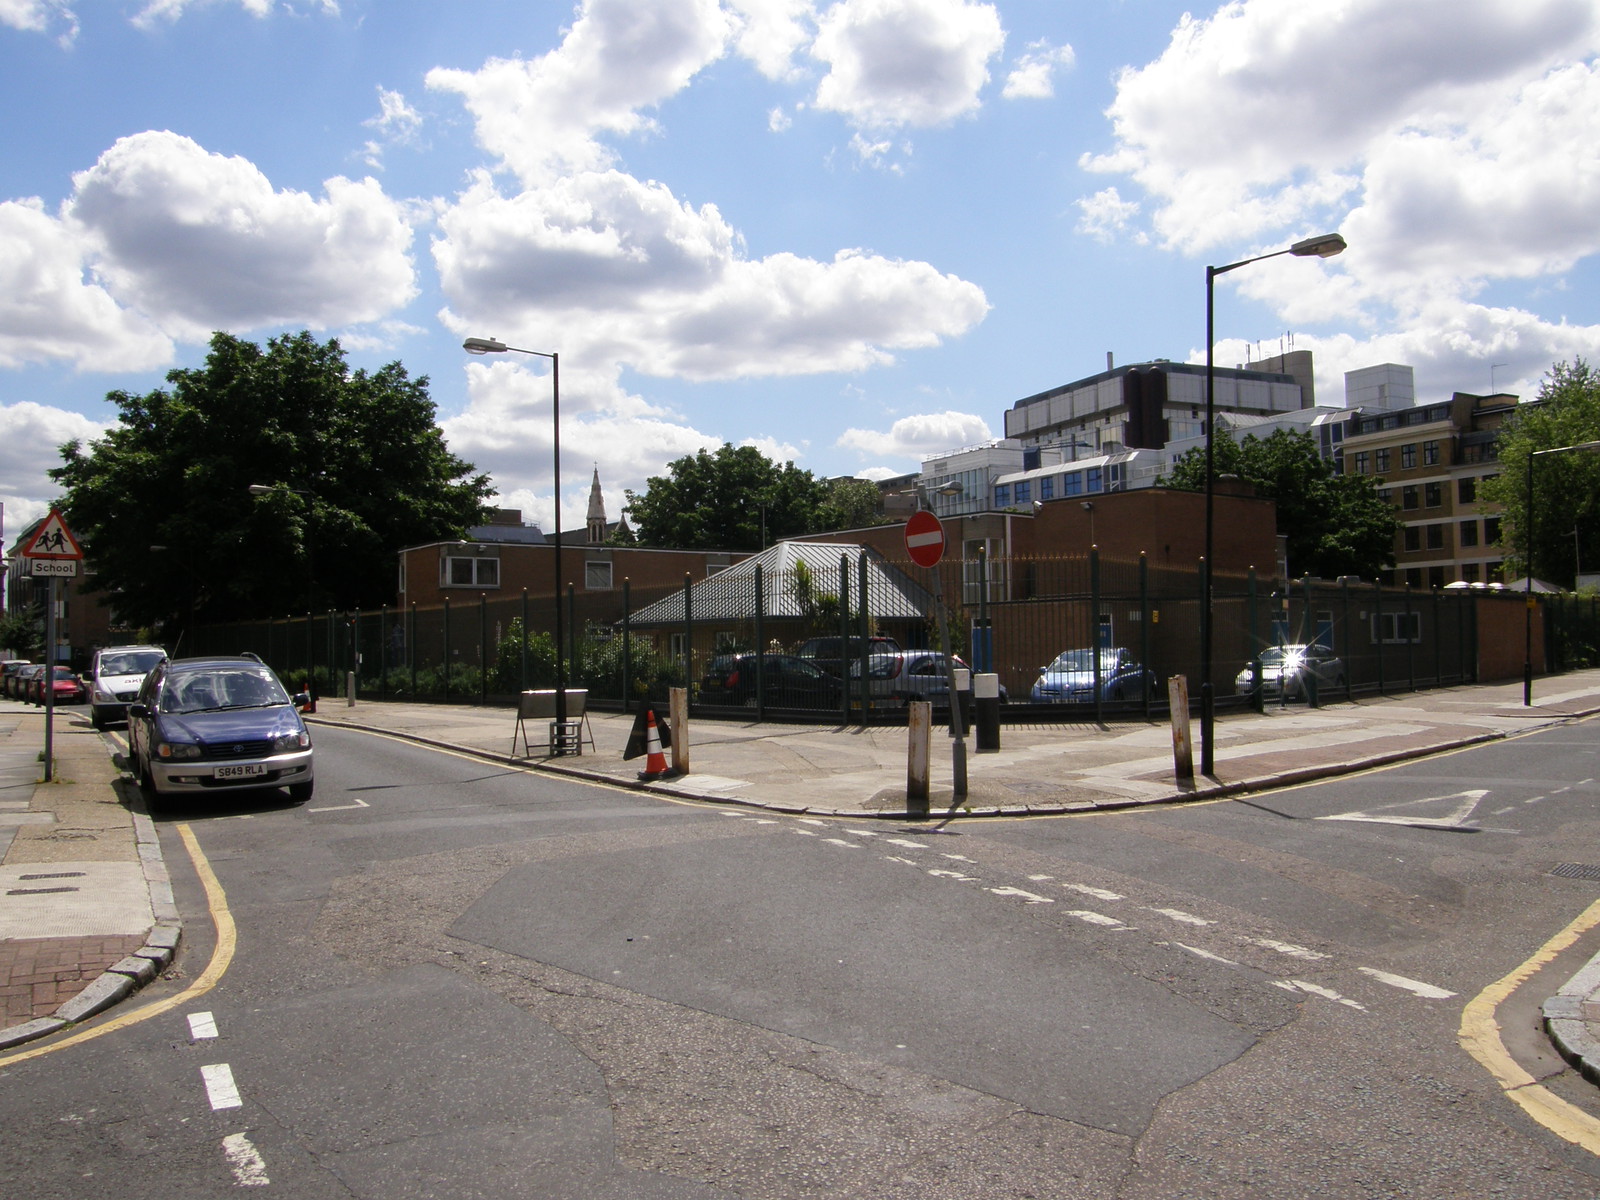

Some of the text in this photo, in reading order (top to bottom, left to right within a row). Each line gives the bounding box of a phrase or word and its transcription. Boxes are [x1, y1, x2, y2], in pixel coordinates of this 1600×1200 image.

[35, 563, 73, 572] School
[218, 765, 264, 777] S849 RLA
